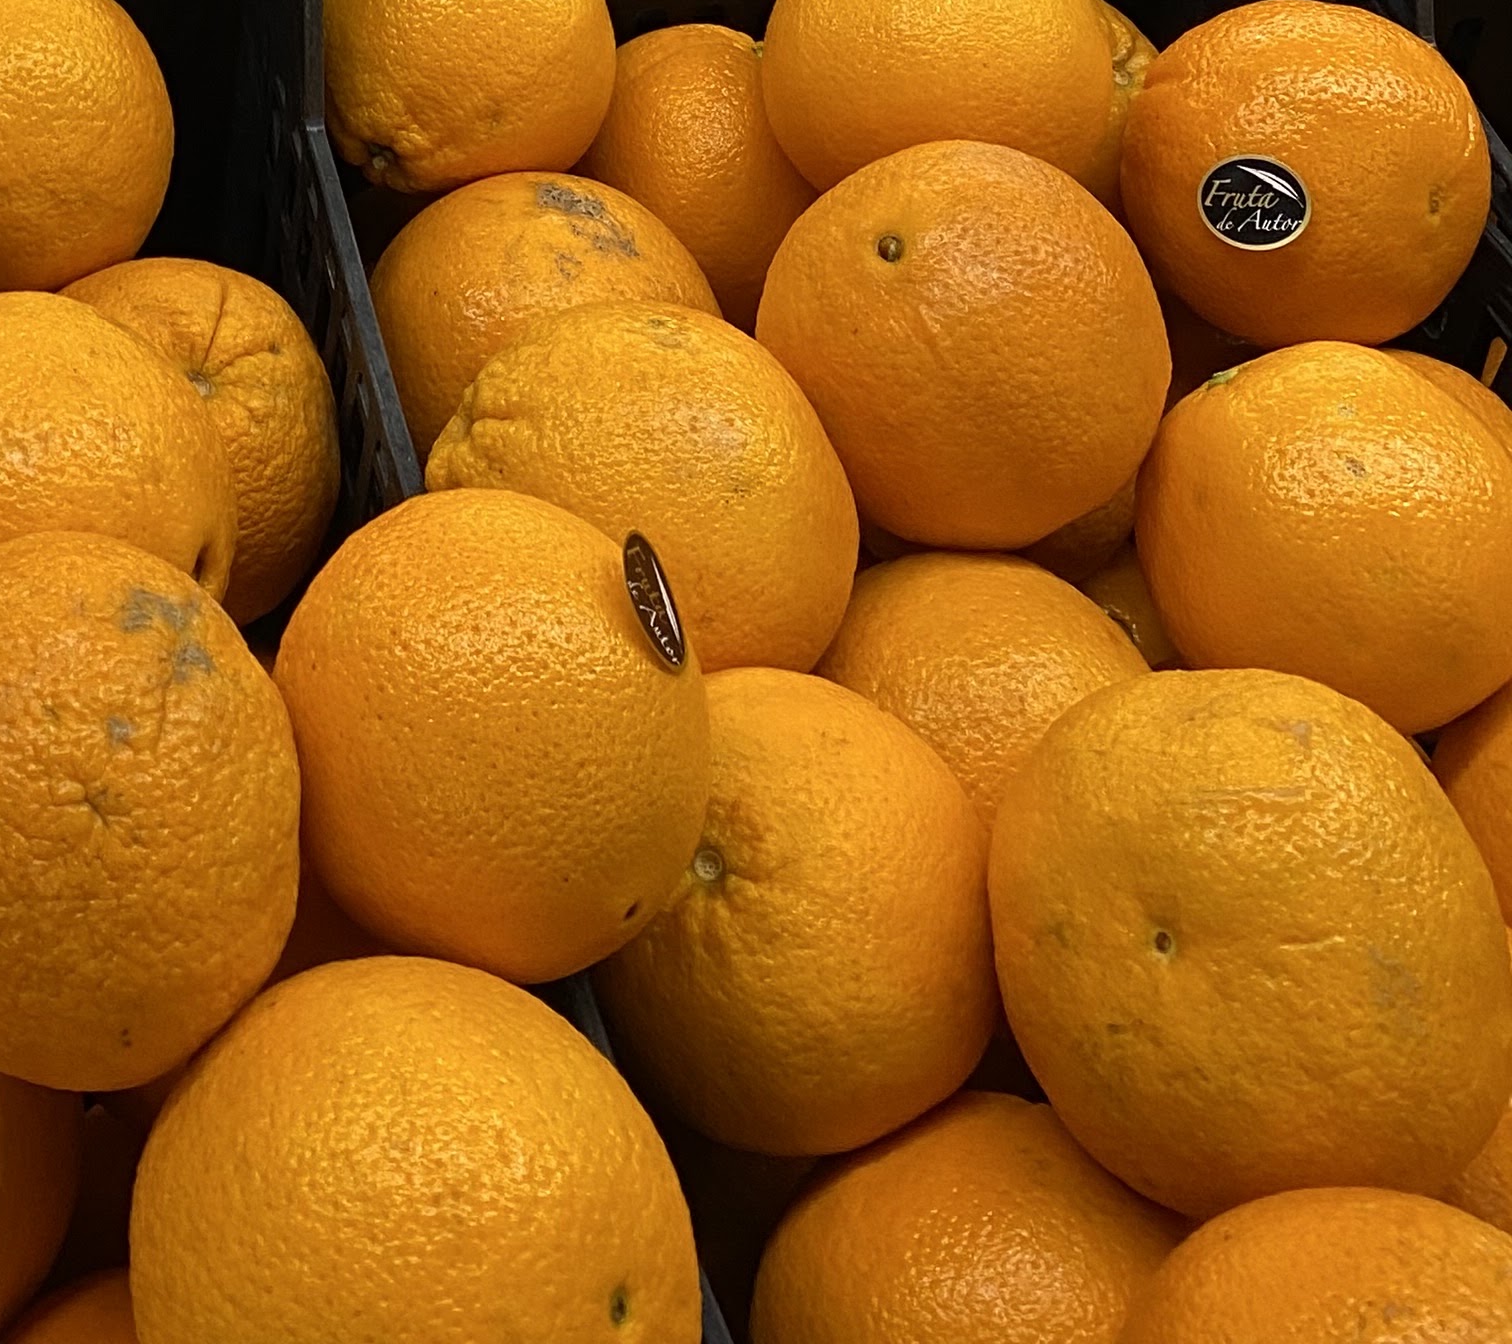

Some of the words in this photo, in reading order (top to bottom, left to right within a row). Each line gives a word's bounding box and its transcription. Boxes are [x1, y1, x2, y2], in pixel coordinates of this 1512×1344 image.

[1204, 178, 1279, 210] Fruta
[1238, 209, 1304, 233] Autor
[626, 545, 668, 625] Fruta
[639, 604, 682, 665] Autor
